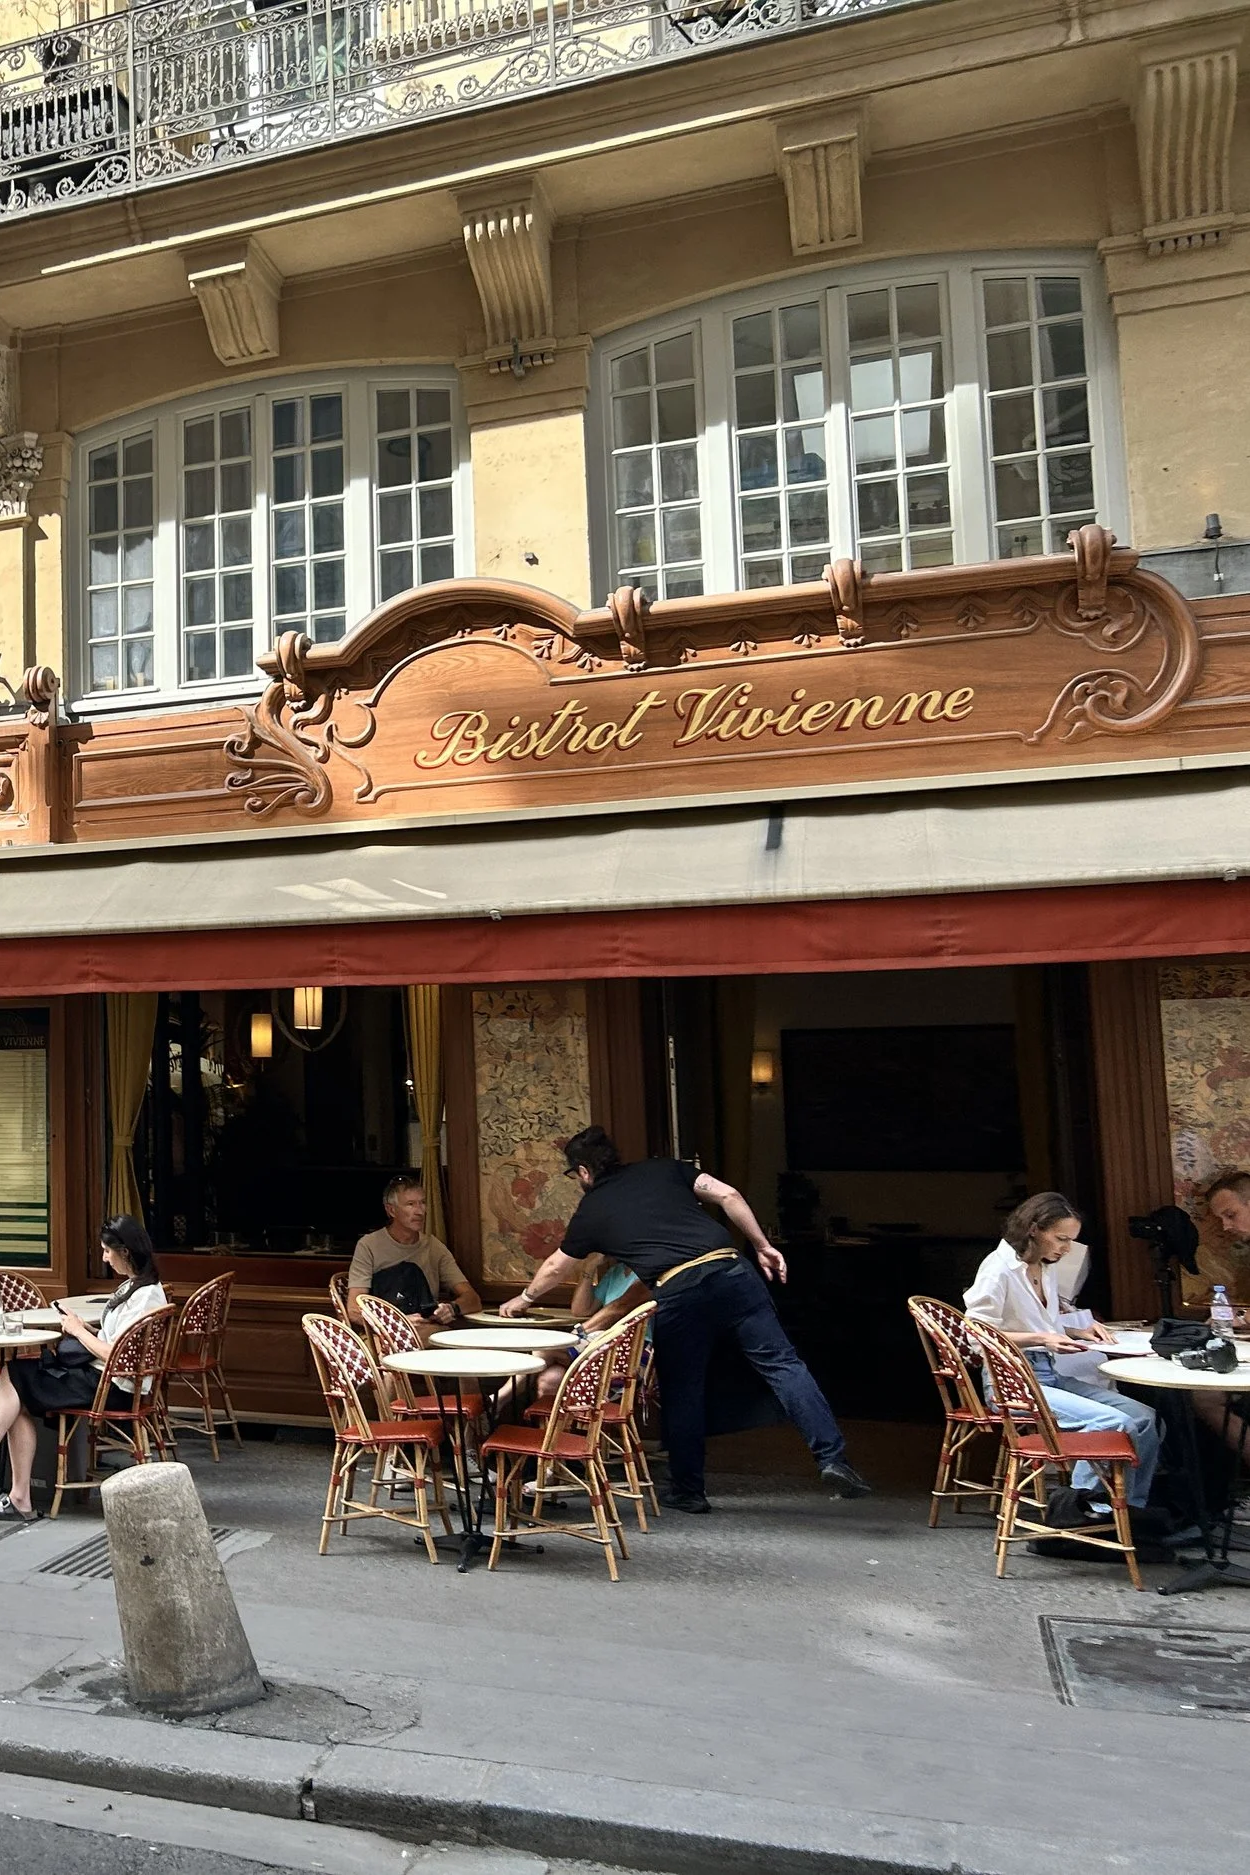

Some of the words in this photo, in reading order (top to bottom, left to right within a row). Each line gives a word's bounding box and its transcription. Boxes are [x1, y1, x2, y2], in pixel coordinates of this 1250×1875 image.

[415, 690, 667, 770] Bistrot
[673, 682, 976, 748] Vivienne
[2, 1035, 46, 1046] VIVIENNE
